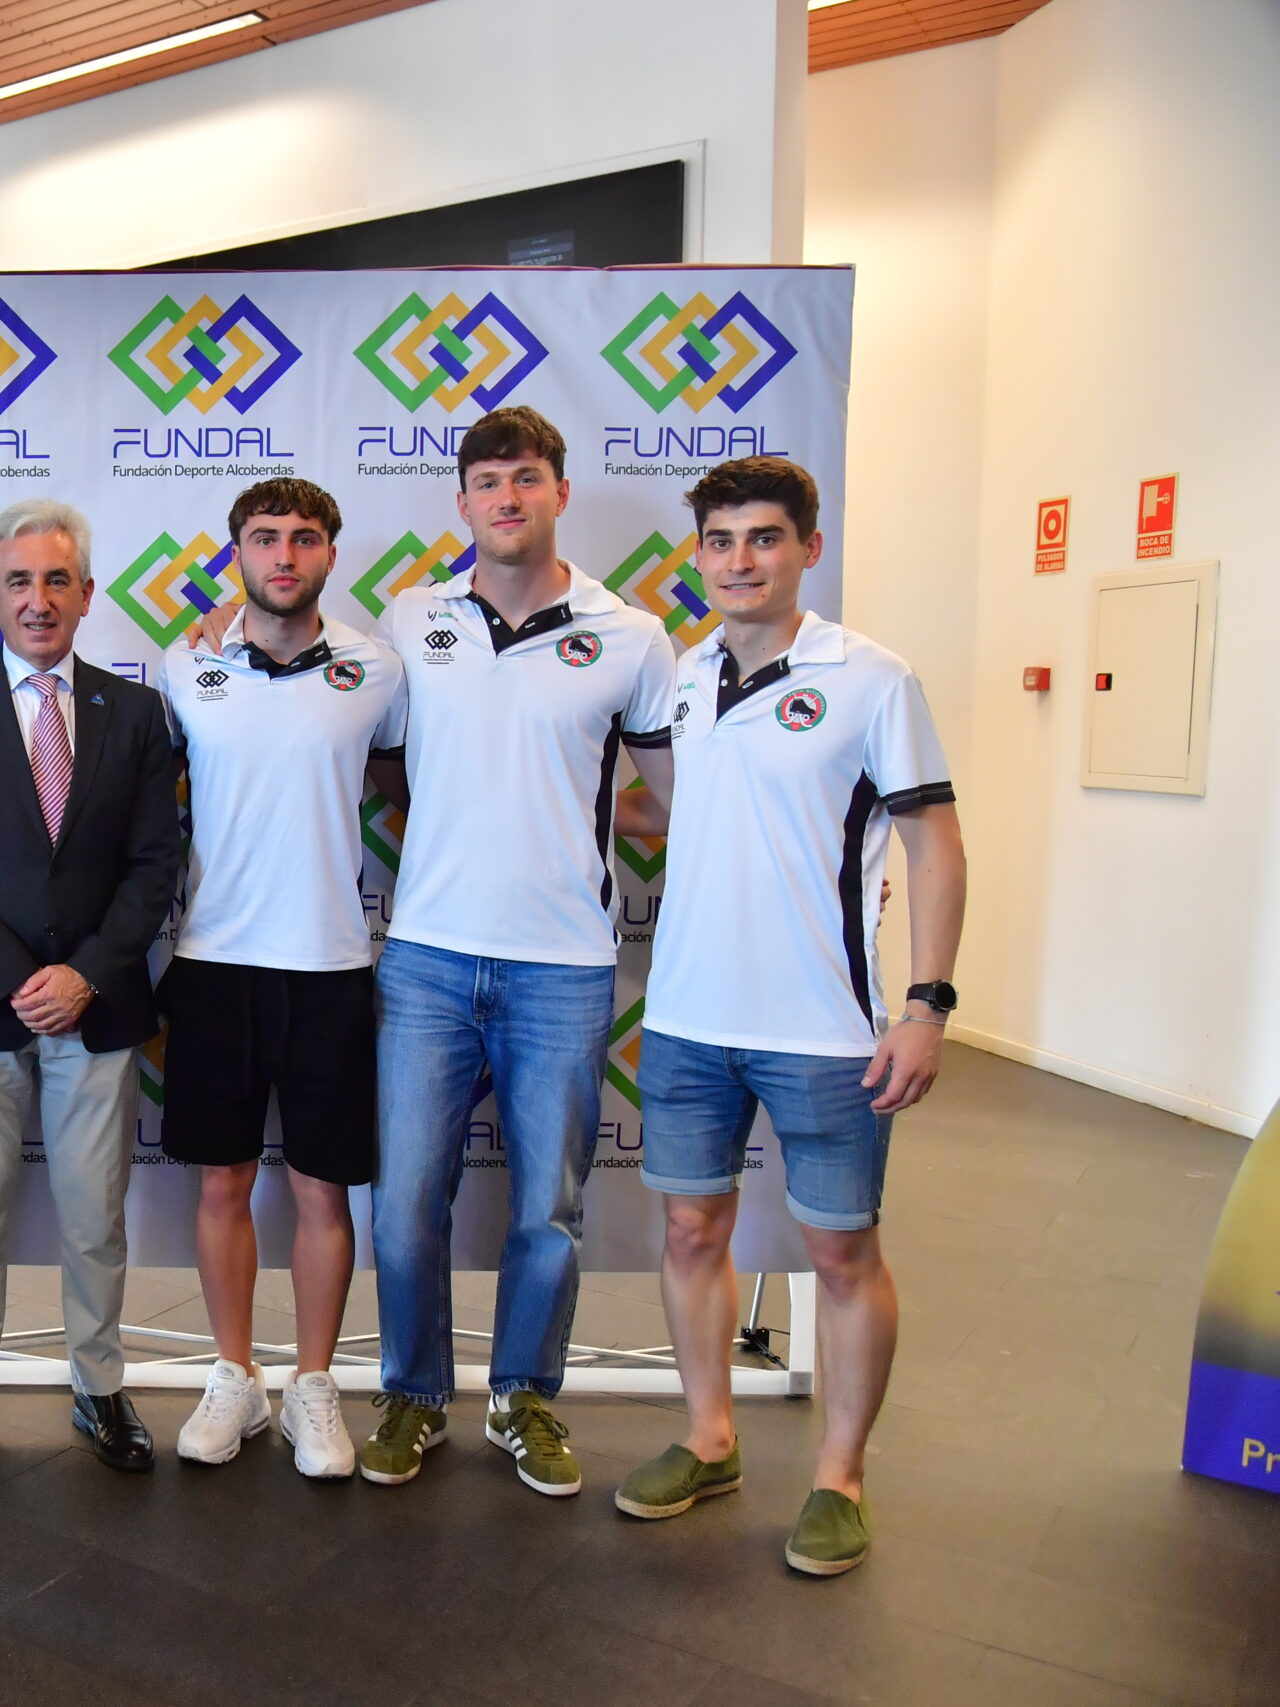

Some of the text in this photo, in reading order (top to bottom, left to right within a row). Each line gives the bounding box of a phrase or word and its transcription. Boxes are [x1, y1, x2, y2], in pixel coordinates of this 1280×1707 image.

[113, 427, 294, 458] FUNDAL
[358, 426, 472, 456] FUND
[605, 426, 789, 457] FUNDAL
[113, 464, 294, 479] Fundación Deporte Alcobendas
[358, 463, 458, 478] Fundación Depor
[605, 463, 662, 476] Fundación
[1140, 535, 1169, 547] BOCA DE
[1137, 545, 1170, 557] INCENDIO
[621, 931, 651, 943] ación
[130, 1153, 166, 1165] dación
[592, 1156, 644, 1168] undación
